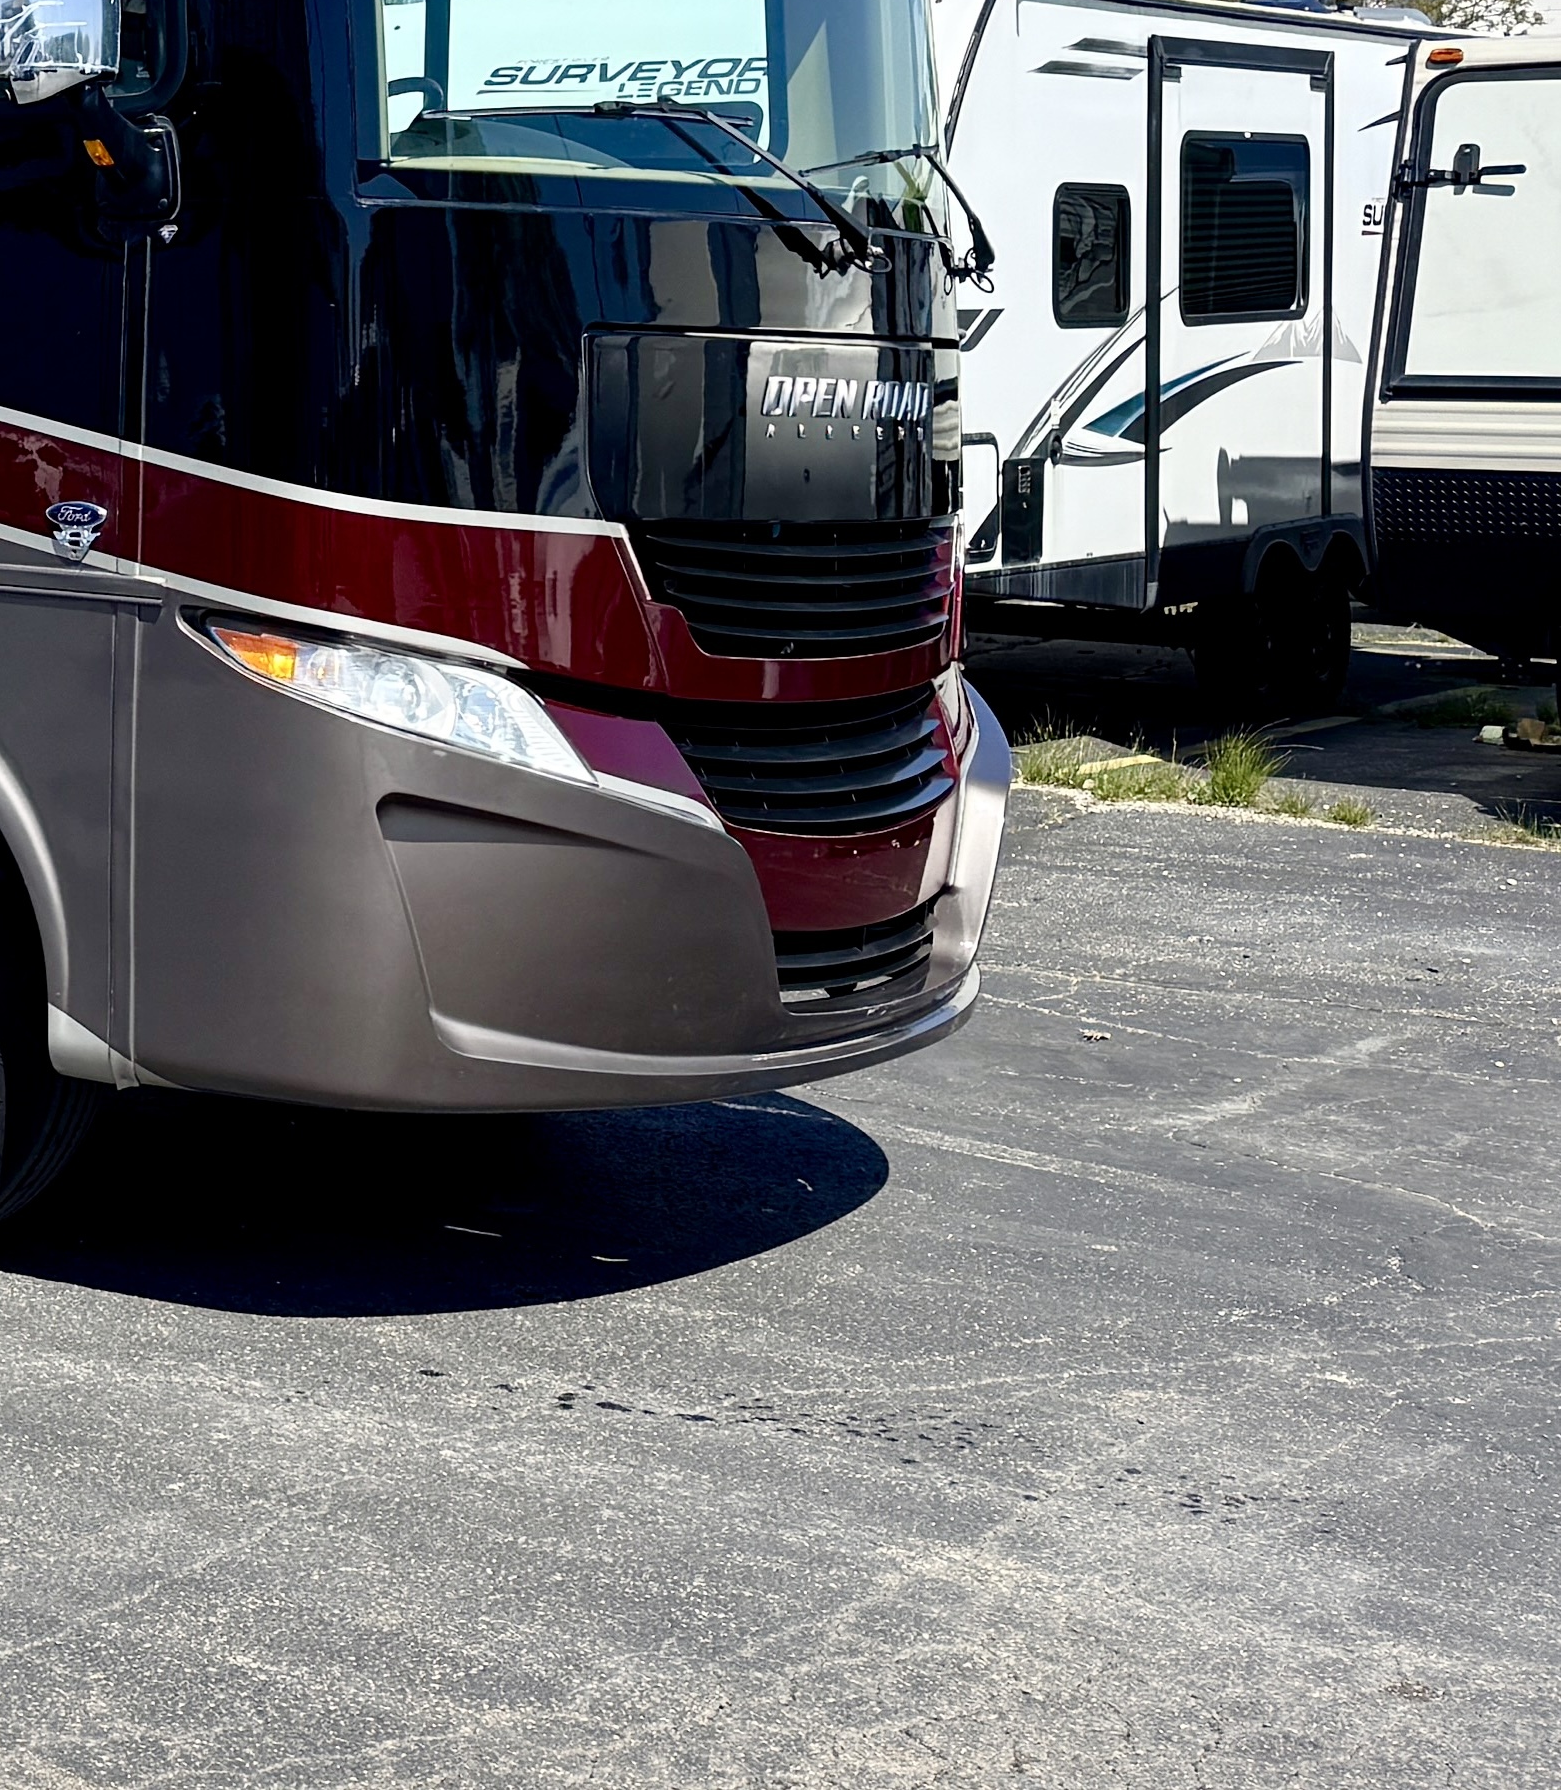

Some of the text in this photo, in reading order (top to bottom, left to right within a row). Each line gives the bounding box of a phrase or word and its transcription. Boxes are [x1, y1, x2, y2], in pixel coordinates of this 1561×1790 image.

[484, 58, 767, 86] SURVEYOR
[616, 78, 761, 99] LEGEND
[762, 376, 930, 421] OPEN ROAD
[57, 505, 91, 522] Ford
